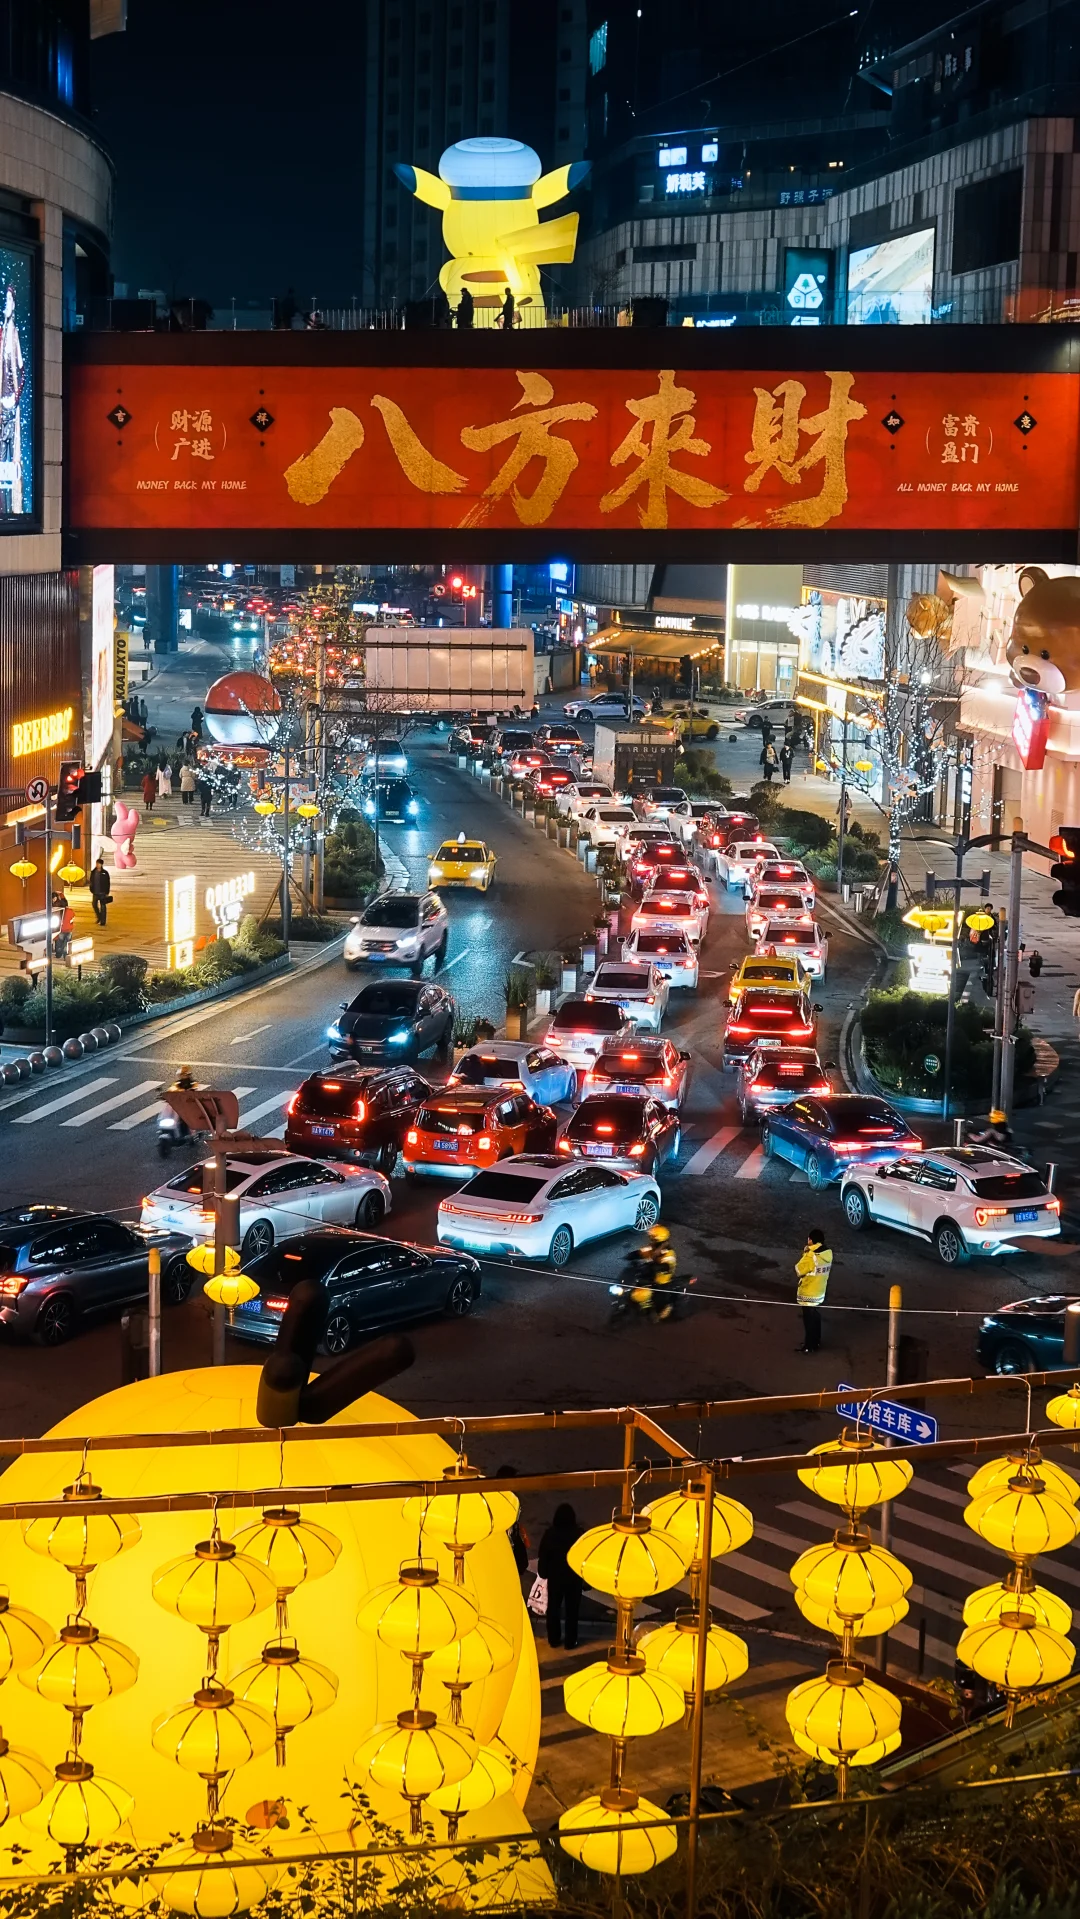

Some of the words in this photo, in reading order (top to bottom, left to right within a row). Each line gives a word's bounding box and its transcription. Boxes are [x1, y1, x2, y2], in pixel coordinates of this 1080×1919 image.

[114, 410, 127, 423] 吉
[170, 409, 213, 432] 财源
[255, 412, 269, 425] 祥
[887, 415, 900, 427] 如
[1020, 415, 1031, 429] 意
[941, 414, 980, 437] 富贵
[170, 438, 215, 460] 广进
[283, 370, 868, 529] 八方來財
[941, 441, 980, 464] 盈门
[136, 480, 169, 490] MONEY
[174, 480, 197, 490] BACK
[201, 480, 217, 490] MY
[221, 480, 247, 490] HOME
[897, 483, 914, 492] ALL
[917, 483, 947, 492] MONEY
[951, 483, 973, 492] BACK
[976, 483, 991, 492] MY
[995, 483, 1019, 492] HOME
[462, 585, 477, 598] 54
[655, 615, 693, 630] COMMUNE
[115, 639, 127, 700] KAALIXTO
